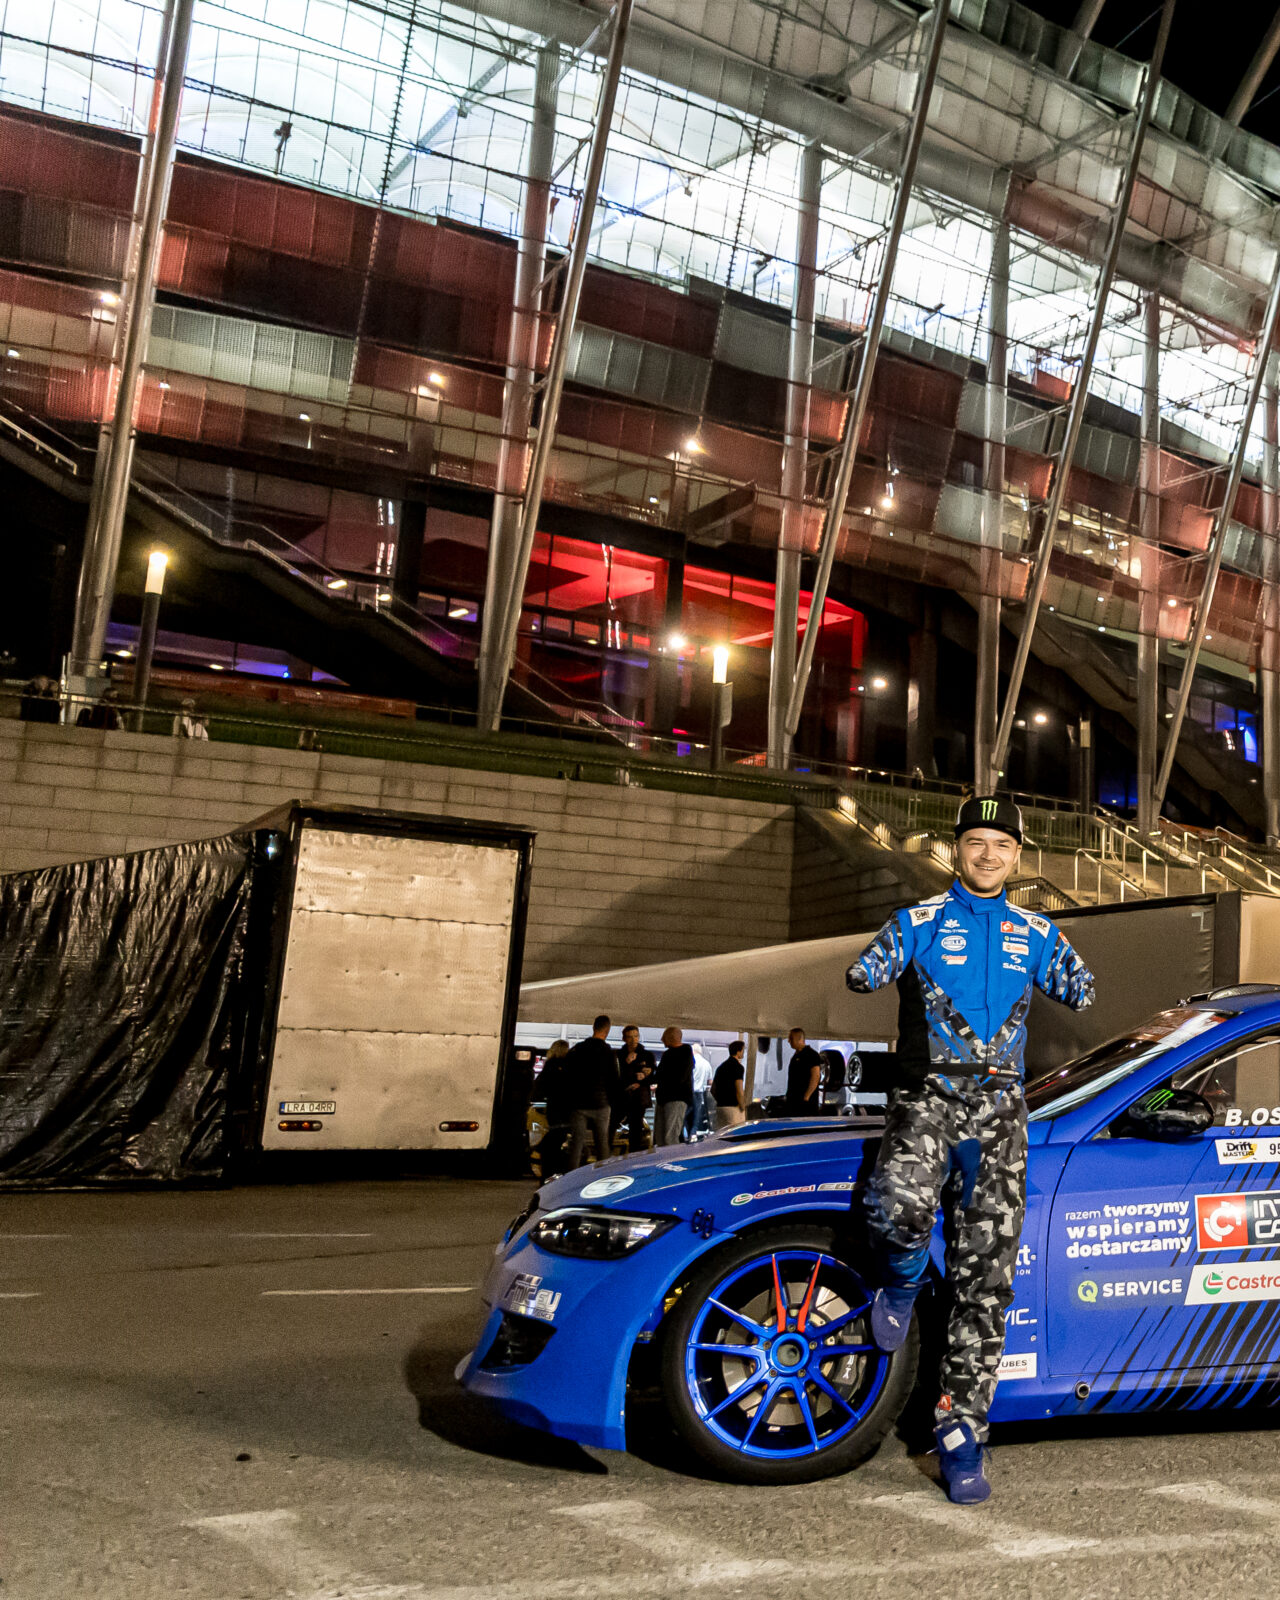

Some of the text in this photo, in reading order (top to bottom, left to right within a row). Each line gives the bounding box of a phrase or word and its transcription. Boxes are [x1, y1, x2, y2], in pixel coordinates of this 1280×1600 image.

[1223, 1150, 1255, 1158] MASTERS
[1226, 1141, 1254, 1152] Drift
[754, 1185, 816, 1199] Castrol
[1065, 1201, 1190, 1220] razem tworzymy
[1066, 1218, 1190, 1240] wspieramy
[1066, 1236, 1192, 1258] dostarczamy
[1102, 1278, 1183, 1298] SERVICE
[1001, 1359, 1028, 1368] UBES
